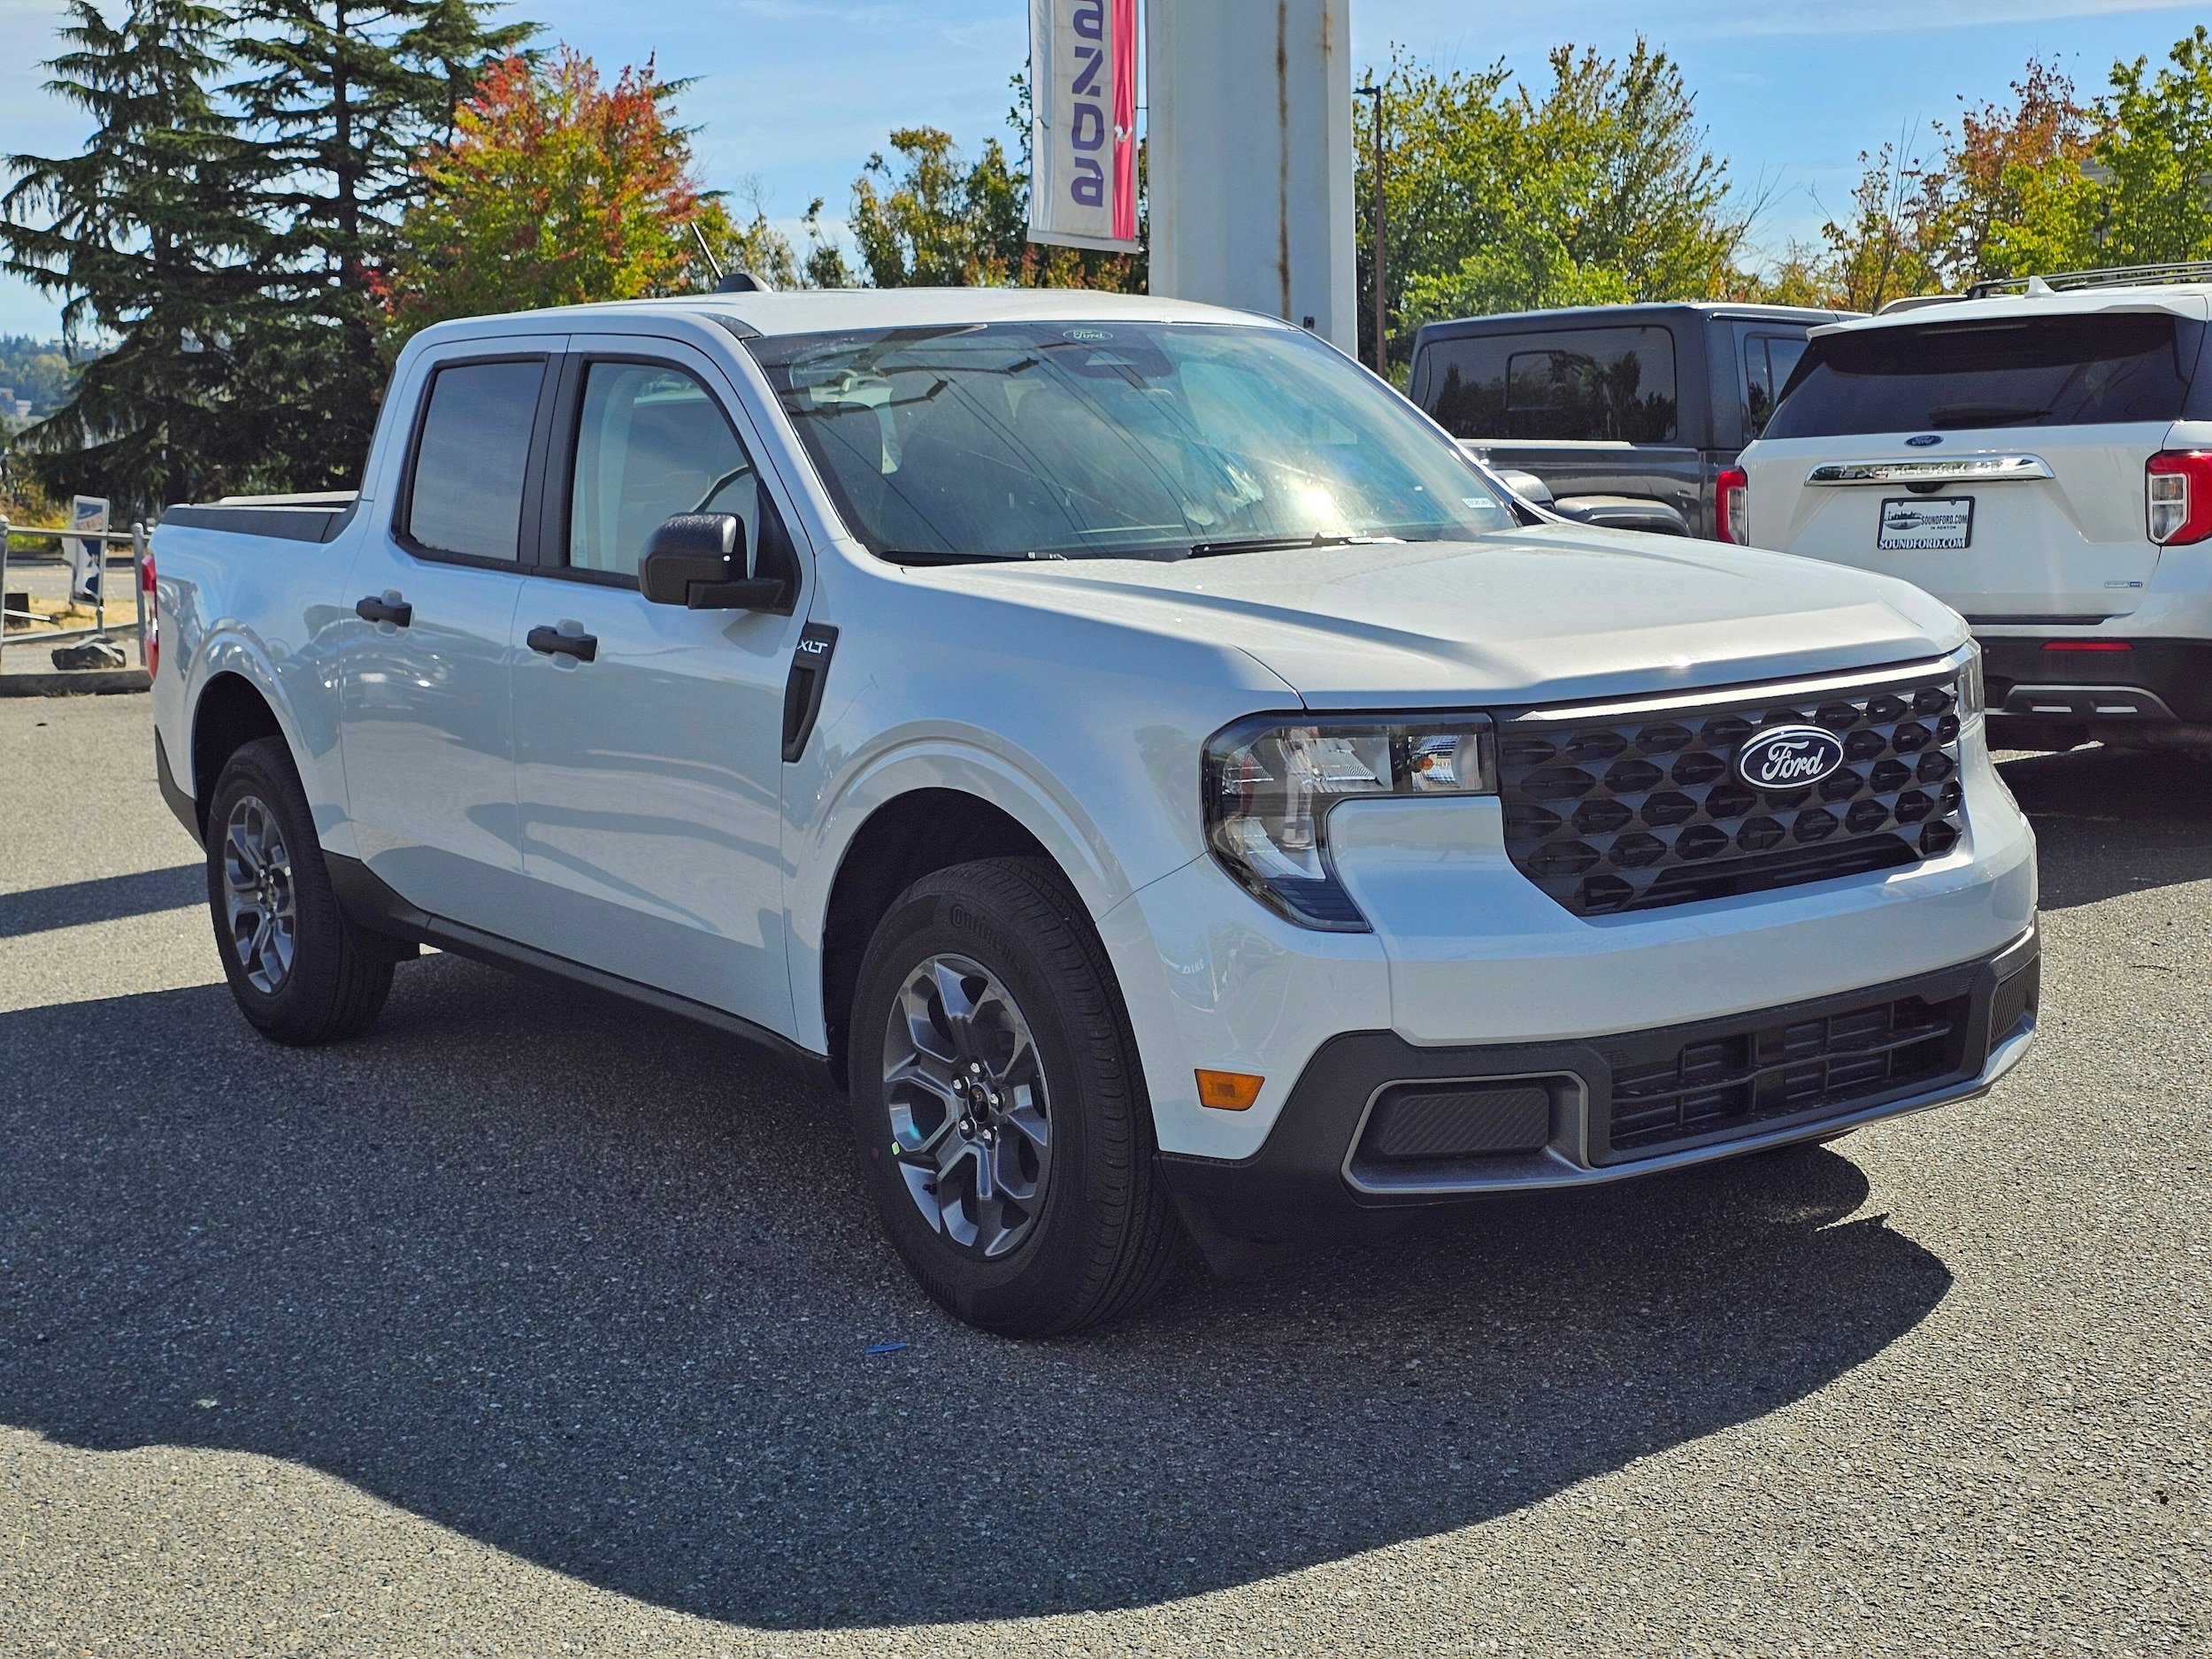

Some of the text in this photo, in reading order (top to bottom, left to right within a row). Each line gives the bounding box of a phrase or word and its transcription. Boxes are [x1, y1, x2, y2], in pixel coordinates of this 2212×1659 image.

[1072, 330, 1106, 340] Ford
[1921, 514, 1968, 526] SOUNDFORD.COM
[1878, 538, 1965, 549] SOUNDFORD.COM
[796, 639, 829, 655] XLT
[1762, 740, 1825, 781] Ford
